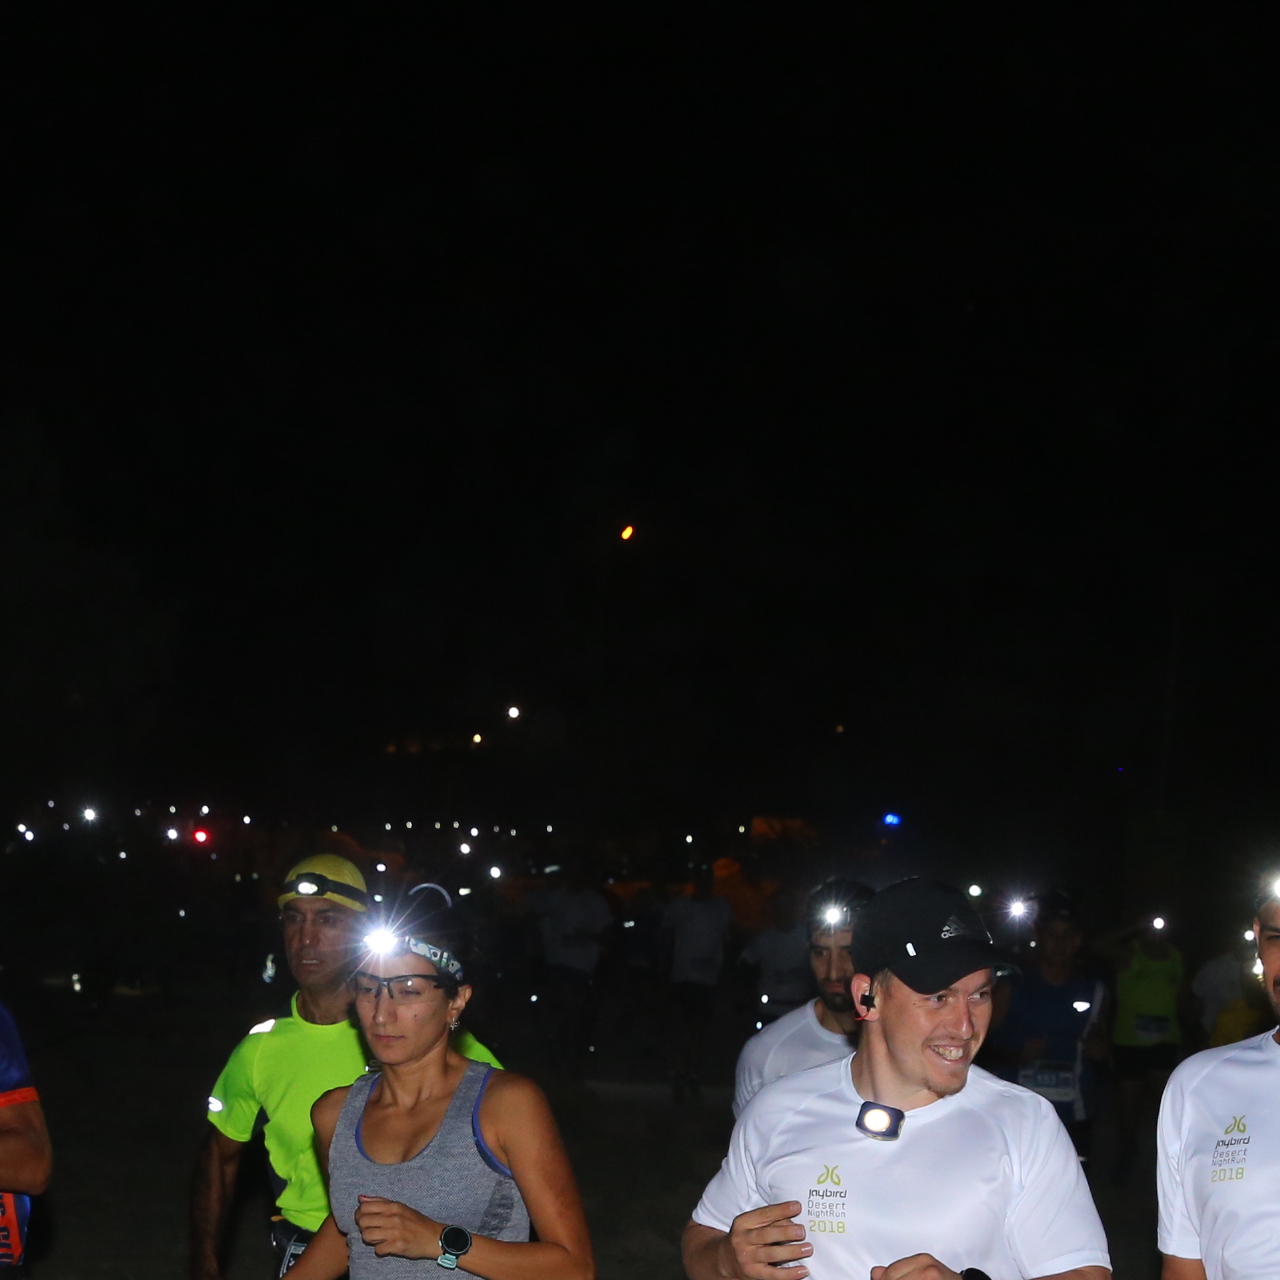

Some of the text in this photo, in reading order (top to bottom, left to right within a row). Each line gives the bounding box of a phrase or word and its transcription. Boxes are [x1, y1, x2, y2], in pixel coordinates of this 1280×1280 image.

[1212, 1148, 1248, 1159] Desert
[1211, 1156, 1247, 1167] NightRun
[1211, 1167, 1245, 1183] 2018
[807, 1199, 847, 1211] Desert
[807, 1209, 846, 1218] NightRun
[808, 1219, 846, 1234] 2018
